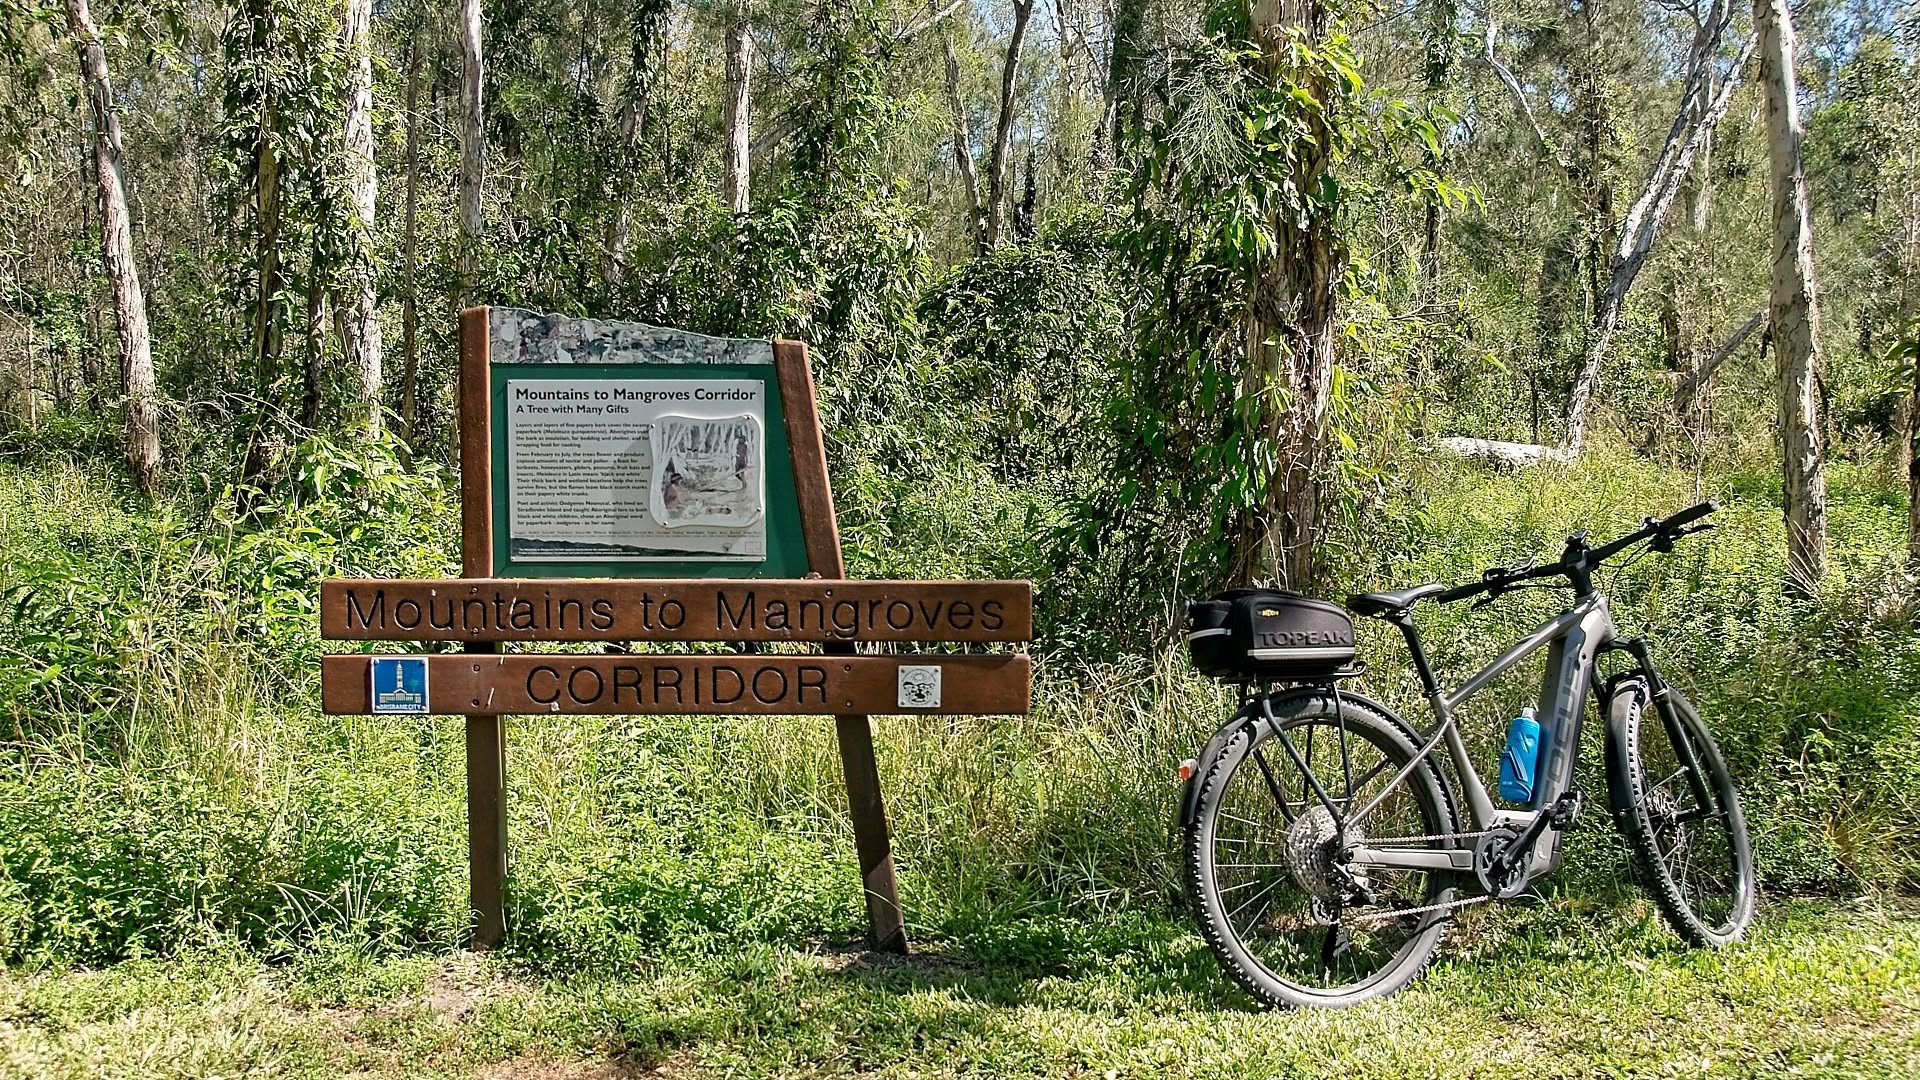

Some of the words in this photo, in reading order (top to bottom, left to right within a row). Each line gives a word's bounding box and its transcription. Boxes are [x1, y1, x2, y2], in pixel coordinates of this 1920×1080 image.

[516, 389, 590, 400] Mountains
[594, 390, 609, 400] to
[614, 389, 690, 403] Mangroves
[694, 389, 756, 400] Corridor
[516, 405, 524, 414] A
[526, 405, 549, 414] Tree
[551, 404, 573, 414] with
[576, 405, 603, 415] Many
[606, 405, 629, 414] Gifts
[346, 589, 615, 631] Mountains
[640, 591, 686, 631] to
[715, 590, 1005, 640] Mangroves
[1257, 630, 1349, 646] TOPEAK
[526, 665, 828, 705] CORRIDOR
